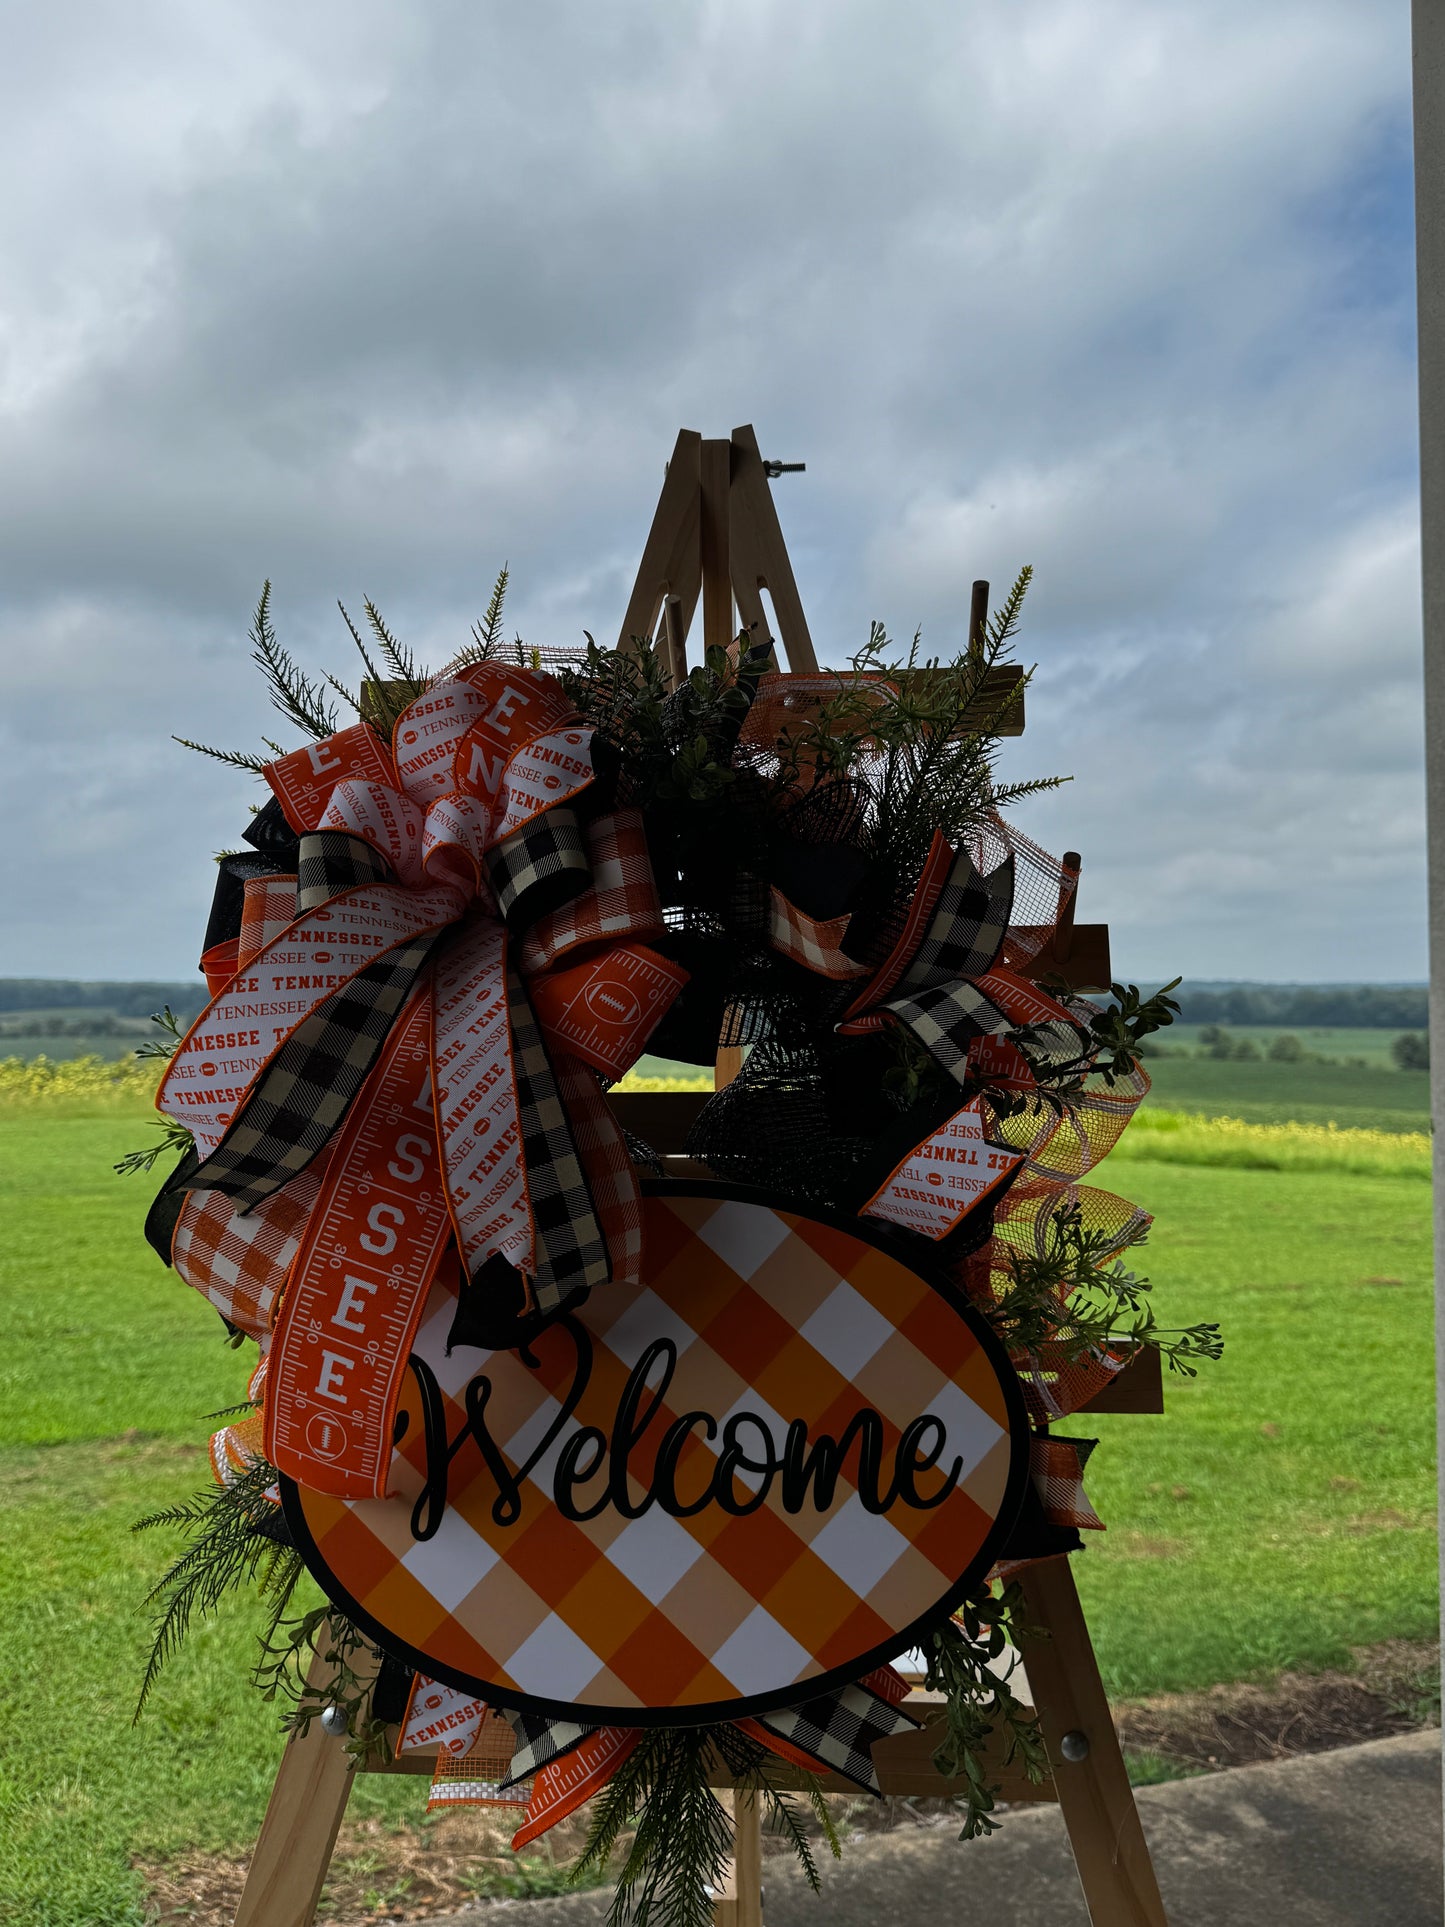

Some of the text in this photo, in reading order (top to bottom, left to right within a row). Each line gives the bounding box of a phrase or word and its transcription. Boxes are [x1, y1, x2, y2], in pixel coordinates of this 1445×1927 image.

[279, 930, 384, 947] ENNESSEE
[213, 1000, 307, 1021] TENNESSEE
[458, 1167, 520, 1226] TENNESSEE
[386, 1263, 405, 1291] 30
[363, 1340, 380, 1367] 20
[351, 1409, 365, 1429] 10
[394, 1314, 964, 1542] Welcome
[541, 1763, 561, 1785] 10
